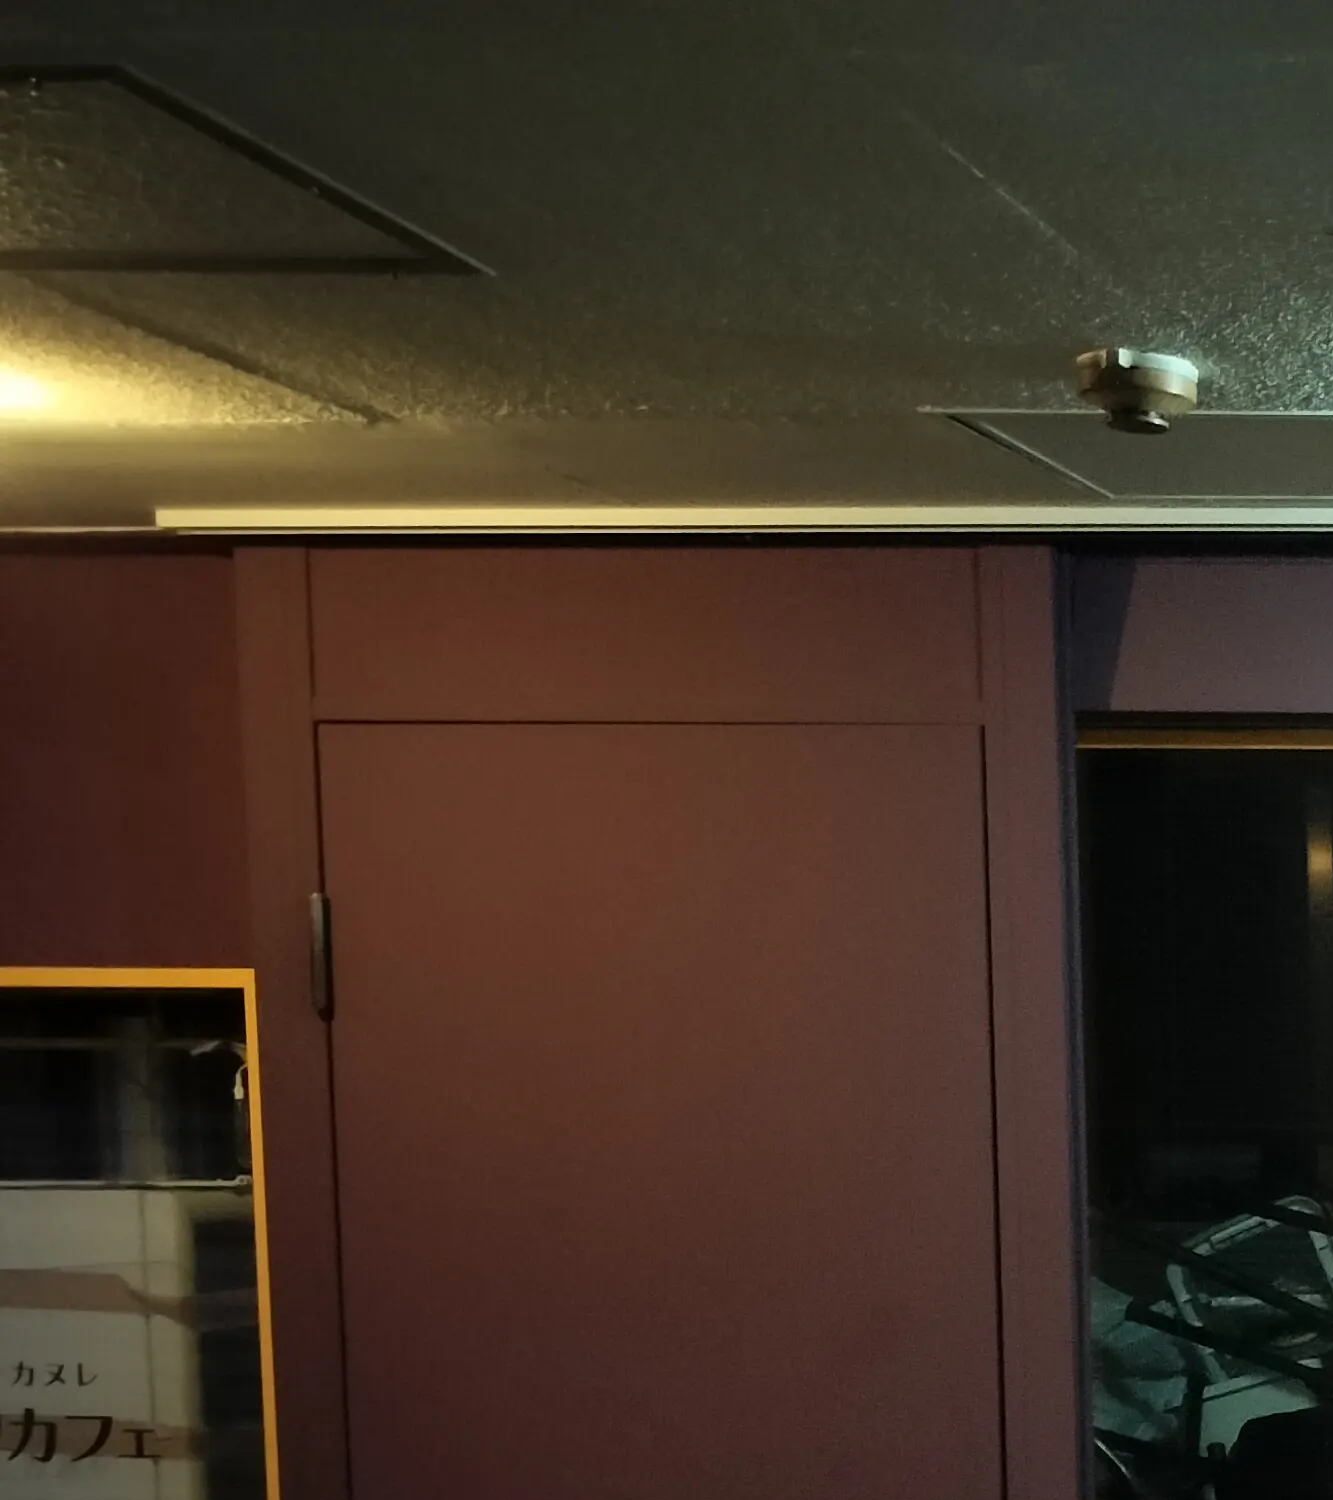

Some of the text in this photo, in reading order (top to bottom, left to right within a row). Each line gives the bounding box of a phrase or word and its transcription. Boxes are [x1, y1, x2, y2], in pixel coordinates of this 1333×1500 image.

[12, 1360, 98, 1387] カヌレ
[0, 1408, 162, 1462] カフェ
